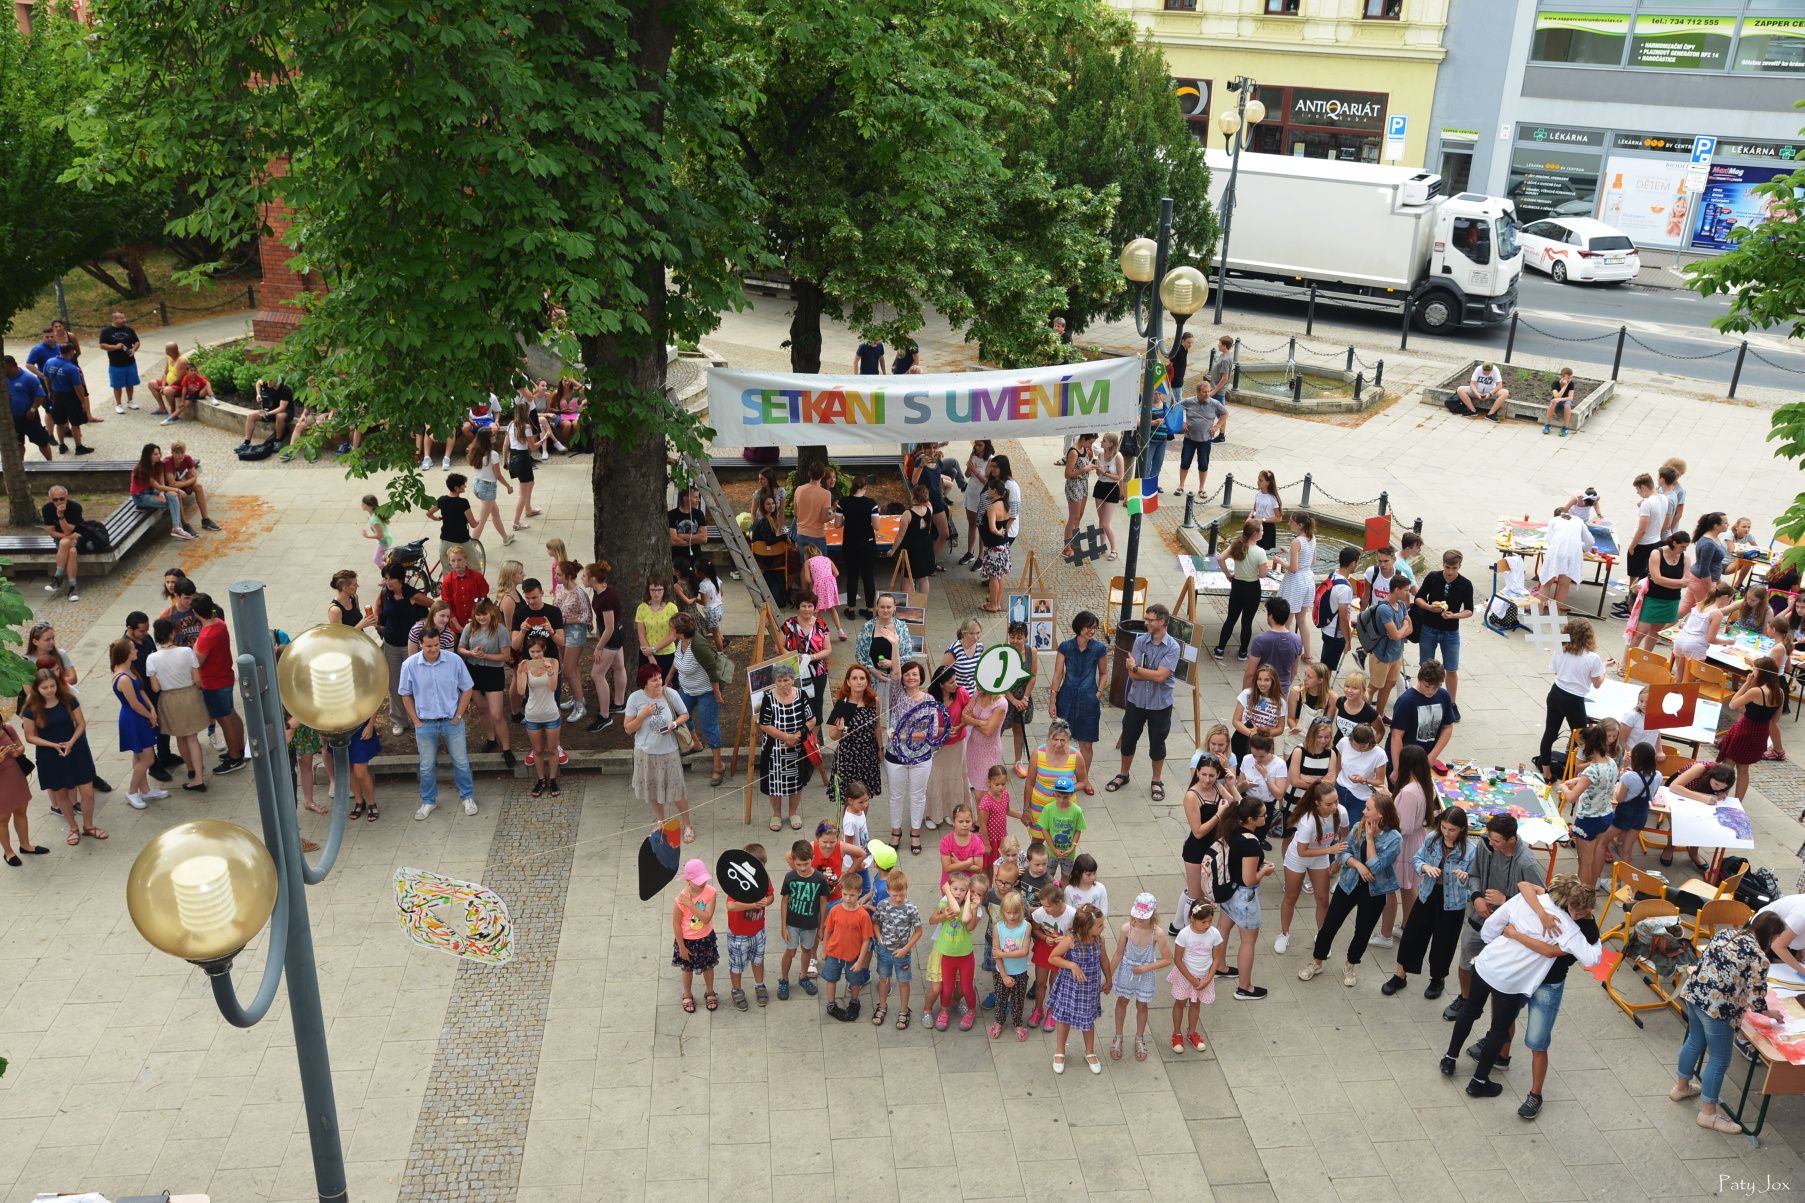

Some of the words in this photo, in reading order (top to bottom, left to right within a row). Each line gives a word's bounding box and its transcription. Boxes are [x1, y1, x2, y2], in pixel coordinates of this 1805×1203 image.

[1754, 20, 1790, 28] ZAPPER
[1792, 20, 1805, 28] CE
[1295, 99, 1381, 120] ANTIQARIÁT
[1549, 131, 1588, 142] LÉKÁRNA
[1617, 138, 1643, 146] LÉKÁRNA
[1731, 145, 1775, 156] LÉKÁRNA
[741, 385, 887, 425] SETKÁNÍ
[903, 390, 932, 425] S
[945, 375, 1110, 424] UMĚNÍM
[789, 881, 821, 902] STAY
